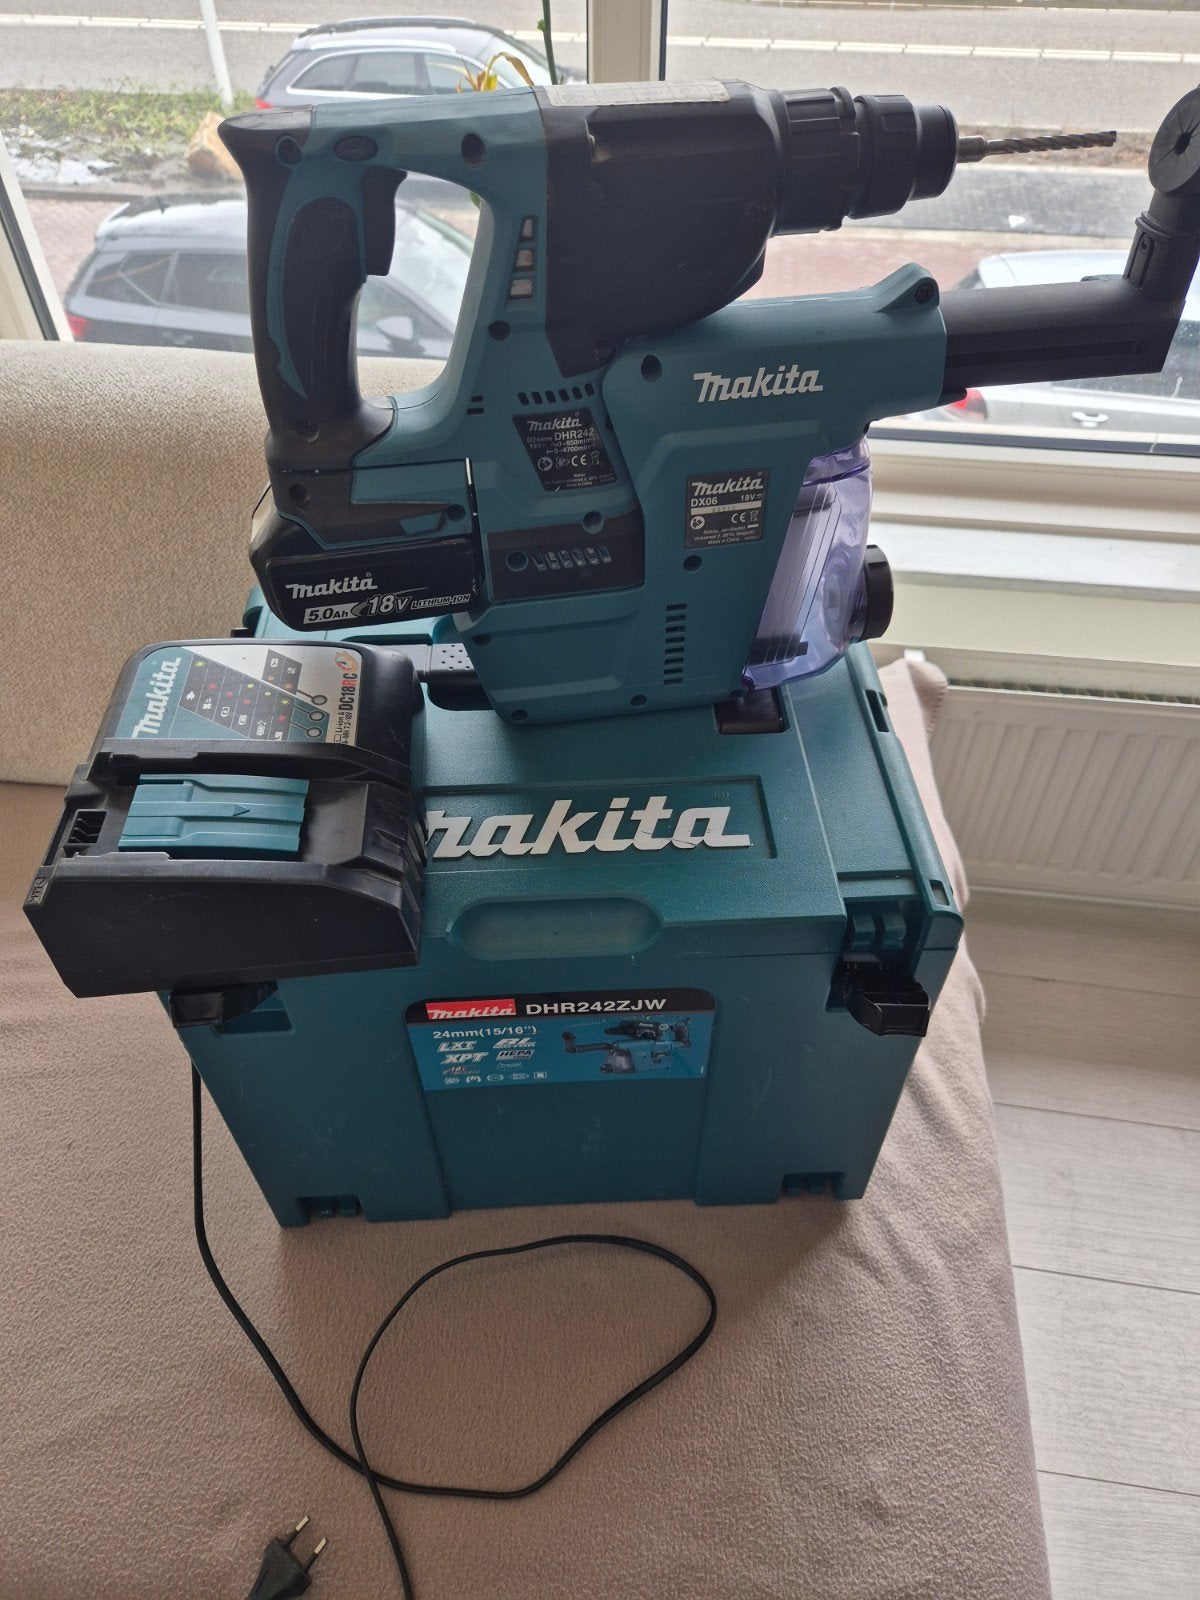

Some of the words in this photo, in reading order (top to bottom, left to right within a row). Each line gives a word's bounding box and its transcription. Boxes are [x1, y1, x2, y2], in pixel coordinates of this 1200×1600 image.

[554, 427, 594, 441] DHR242
[691, 496, 718, 507] DX06
[740, 493, 755, 502] 18V
[308, 607, 349, 622] 5.0Ah
[338, 672, 358, 711] DC18RC
[525, 998, 667, 1015] DHR242ZJW
[440, 1051, 489, 1065] XPT
